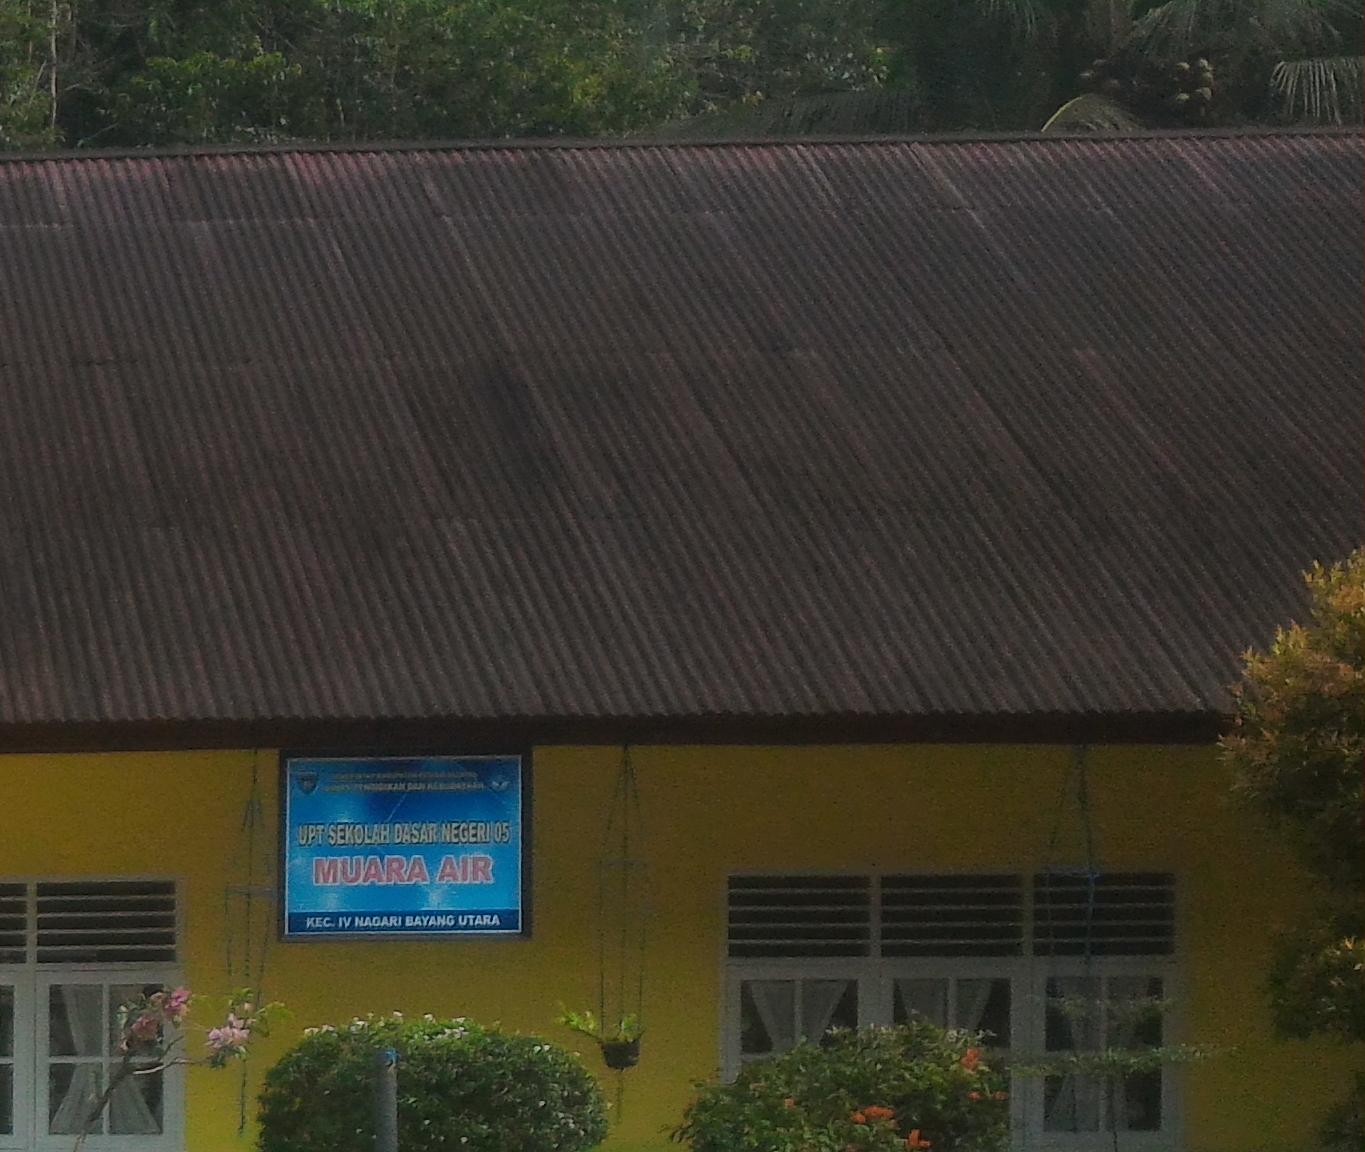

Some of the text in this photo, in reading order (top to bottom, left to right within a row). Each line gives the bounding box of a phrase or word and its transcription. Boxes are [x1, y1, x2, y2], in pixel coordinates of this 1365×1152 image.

[298, 821, 510, 846] UPT SEKOLAH DASAR NEGERI 05
[313, 855, 494, 886] MUARA AIR
[306, 914, 501, 929] KEC. IV NAGARI BAYANG UTARA
